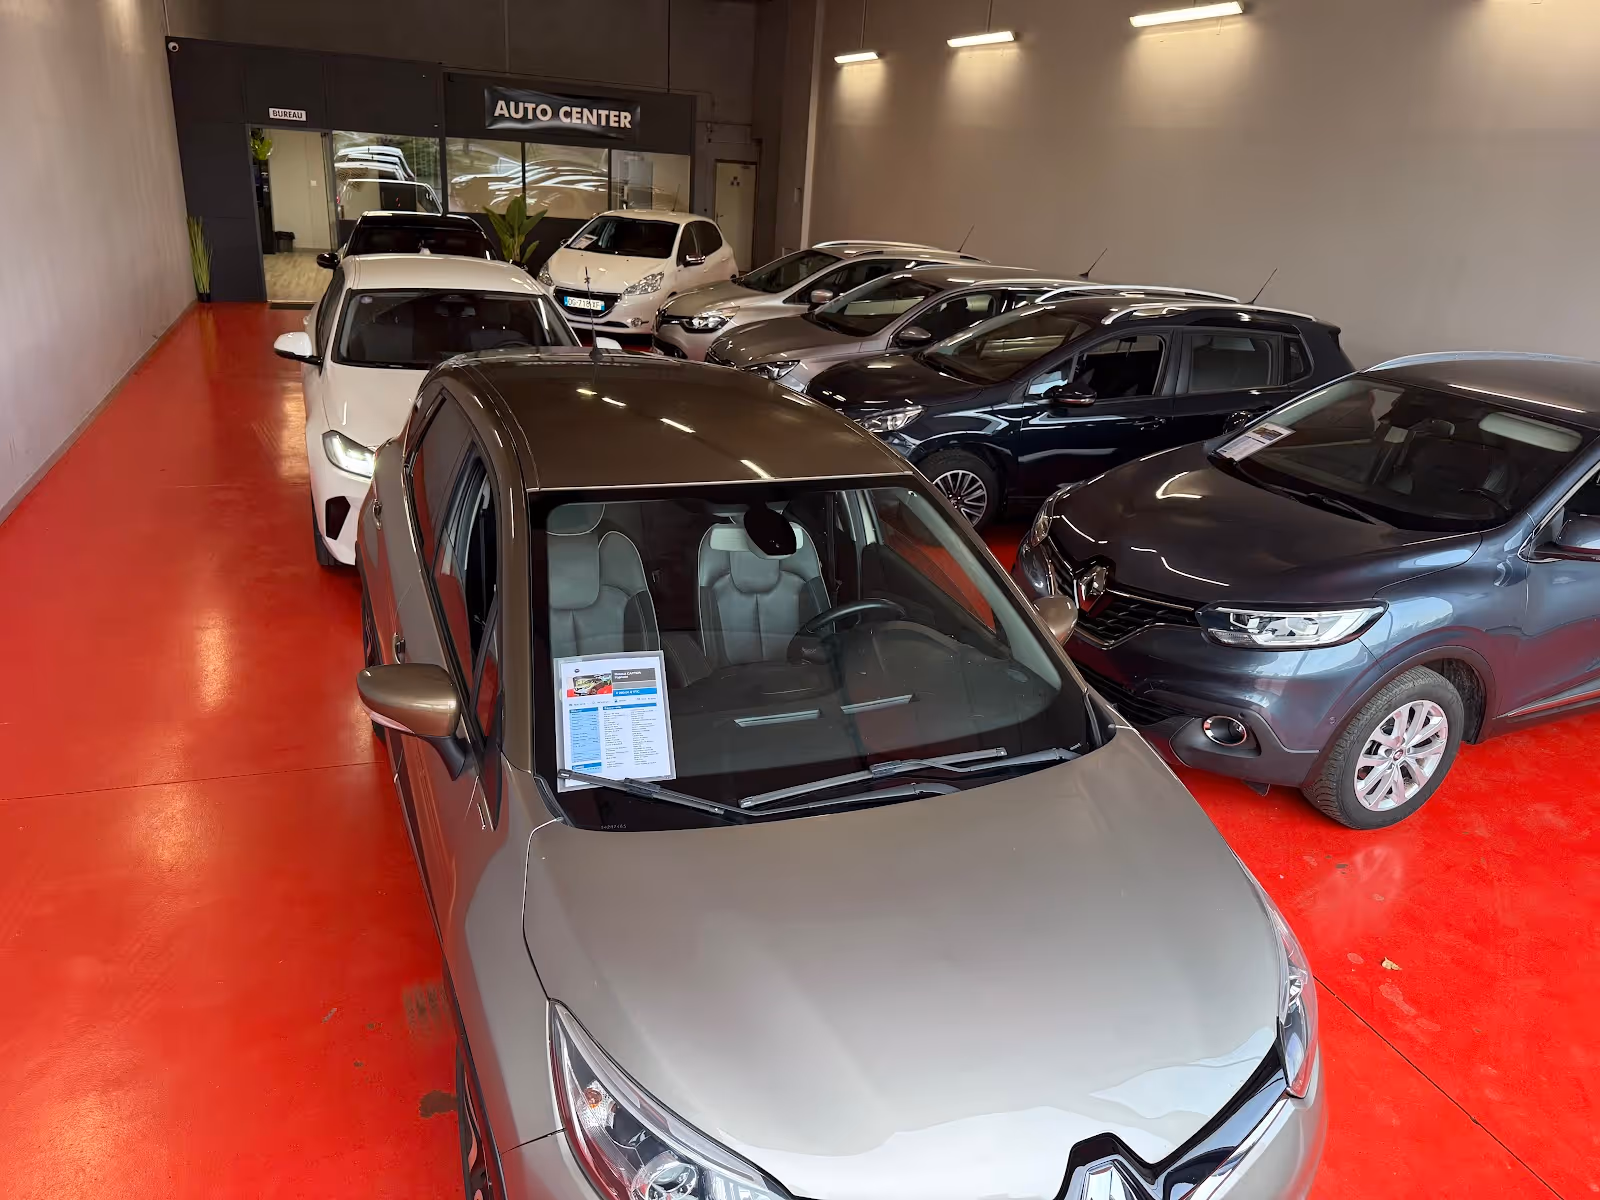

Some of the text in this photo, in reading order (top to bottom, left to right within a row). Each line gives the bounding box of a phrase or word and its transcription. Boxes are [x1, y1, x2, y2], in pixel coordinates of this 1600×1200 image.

[272, 110, 303, 119] BUREAU
[494, 100, 632, 128] AUTO CENTER
